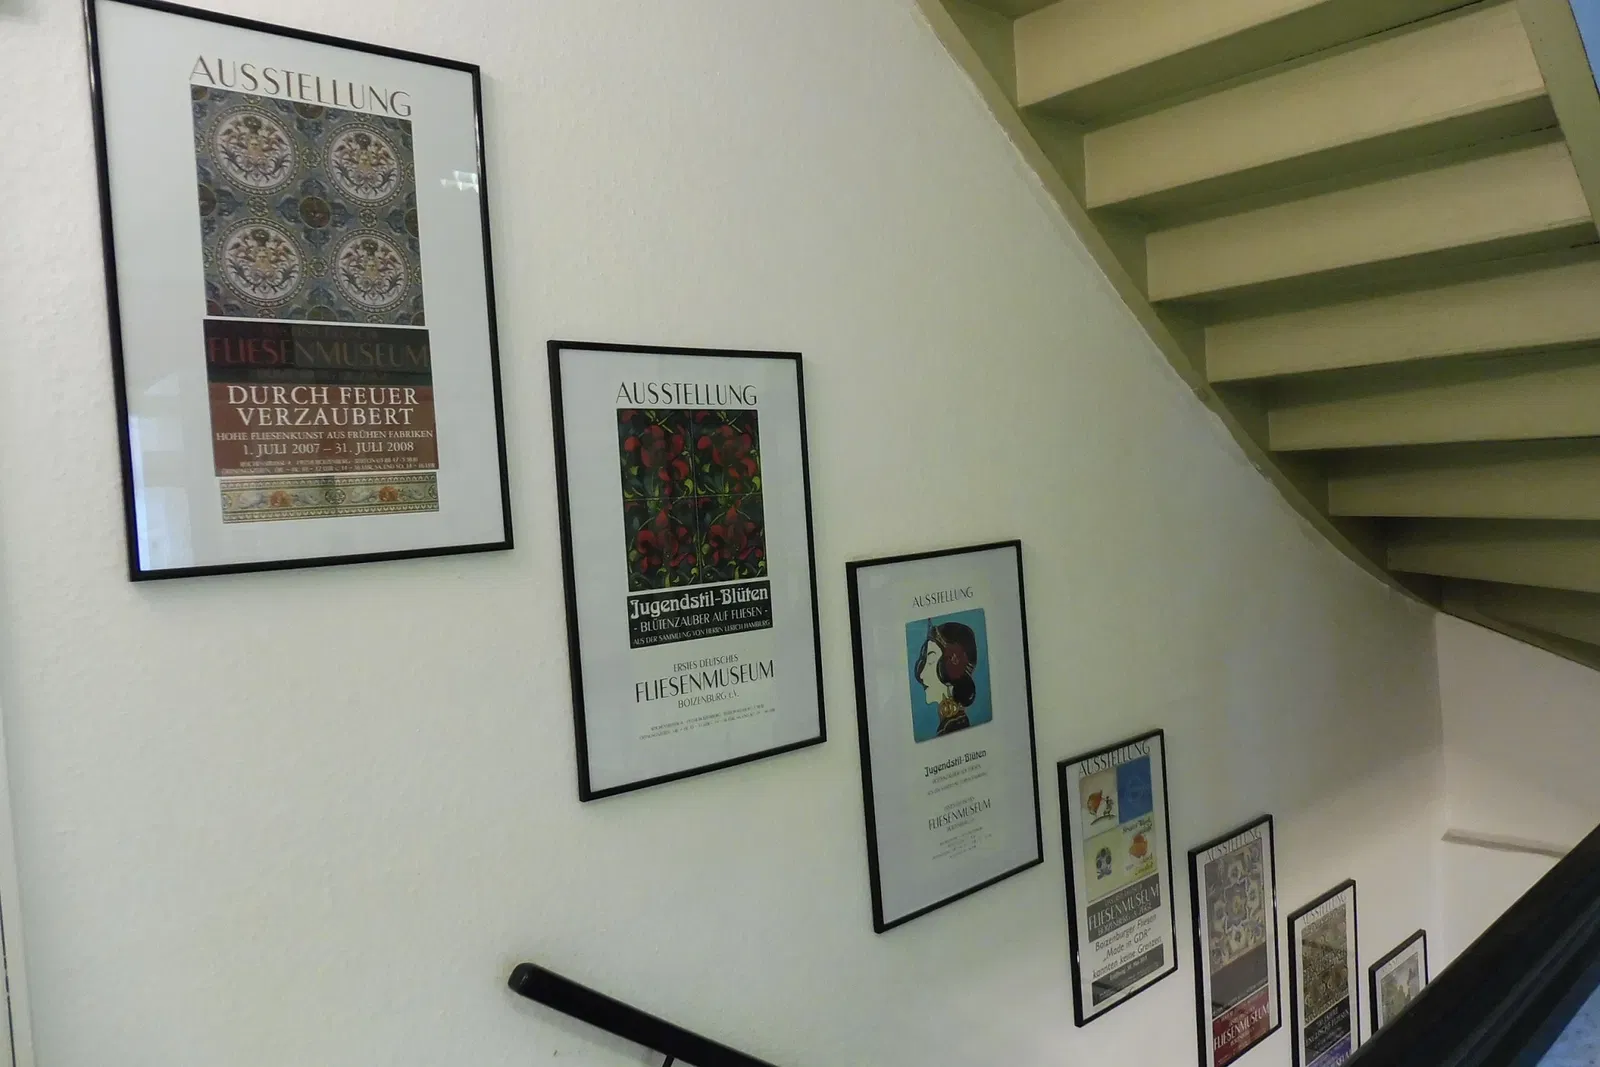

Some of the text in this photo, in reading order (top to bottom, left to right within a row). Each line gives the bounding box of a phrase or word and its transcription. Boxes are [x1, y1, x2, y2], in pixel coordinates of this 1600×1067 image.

[189, 54, 412, 117] AUSSTELLUNG
[207, 337, 429, 368] FLIESENMUSEUM
[227, 385, 419, 405] DURCH FEUER
[615, 381, 757, 406] AUSSTELLUNG
[236, 407, 414, 426] VERZAUBERT
[216, 429, 433, 440] HOHE FLIESENKUNST AUS FRÜHEN FABRIKEN
[243, 444, 254, 455] 1.
[255, 443, 287, 457] JULI
[291, 443, 320, 454] 2007
[335, 442, 353, 454] 31.
[355, 441, 383, 456] JULI
[387, 441, 414, 452] 2008
[630, 587, 769, 619] Jugendstil-Blüten
[912, 586, 974, 608] AUSSTELLUNG
[640, 613, 710, 633] BLÜTENZAUBER
[712, 610, 729, 622] AUF
[731, 606, 763, 620] FLIESEN
[673, 654, 739, 672] ERSTES DEUTSCHES
[635, 660, 774, 703] FLIESENMUSEUM
[678, 690, 727, 708] BOIZENBURG
[924, 750, 987, 777] Jugendstil-Blüten
[1079, 740, 1150, 776] AUSSTELLUNG
[928, 798, 991, 831] FLIESENMUSEUM
[1088, 883, 1159, 931] FLIESENMUSEUM
